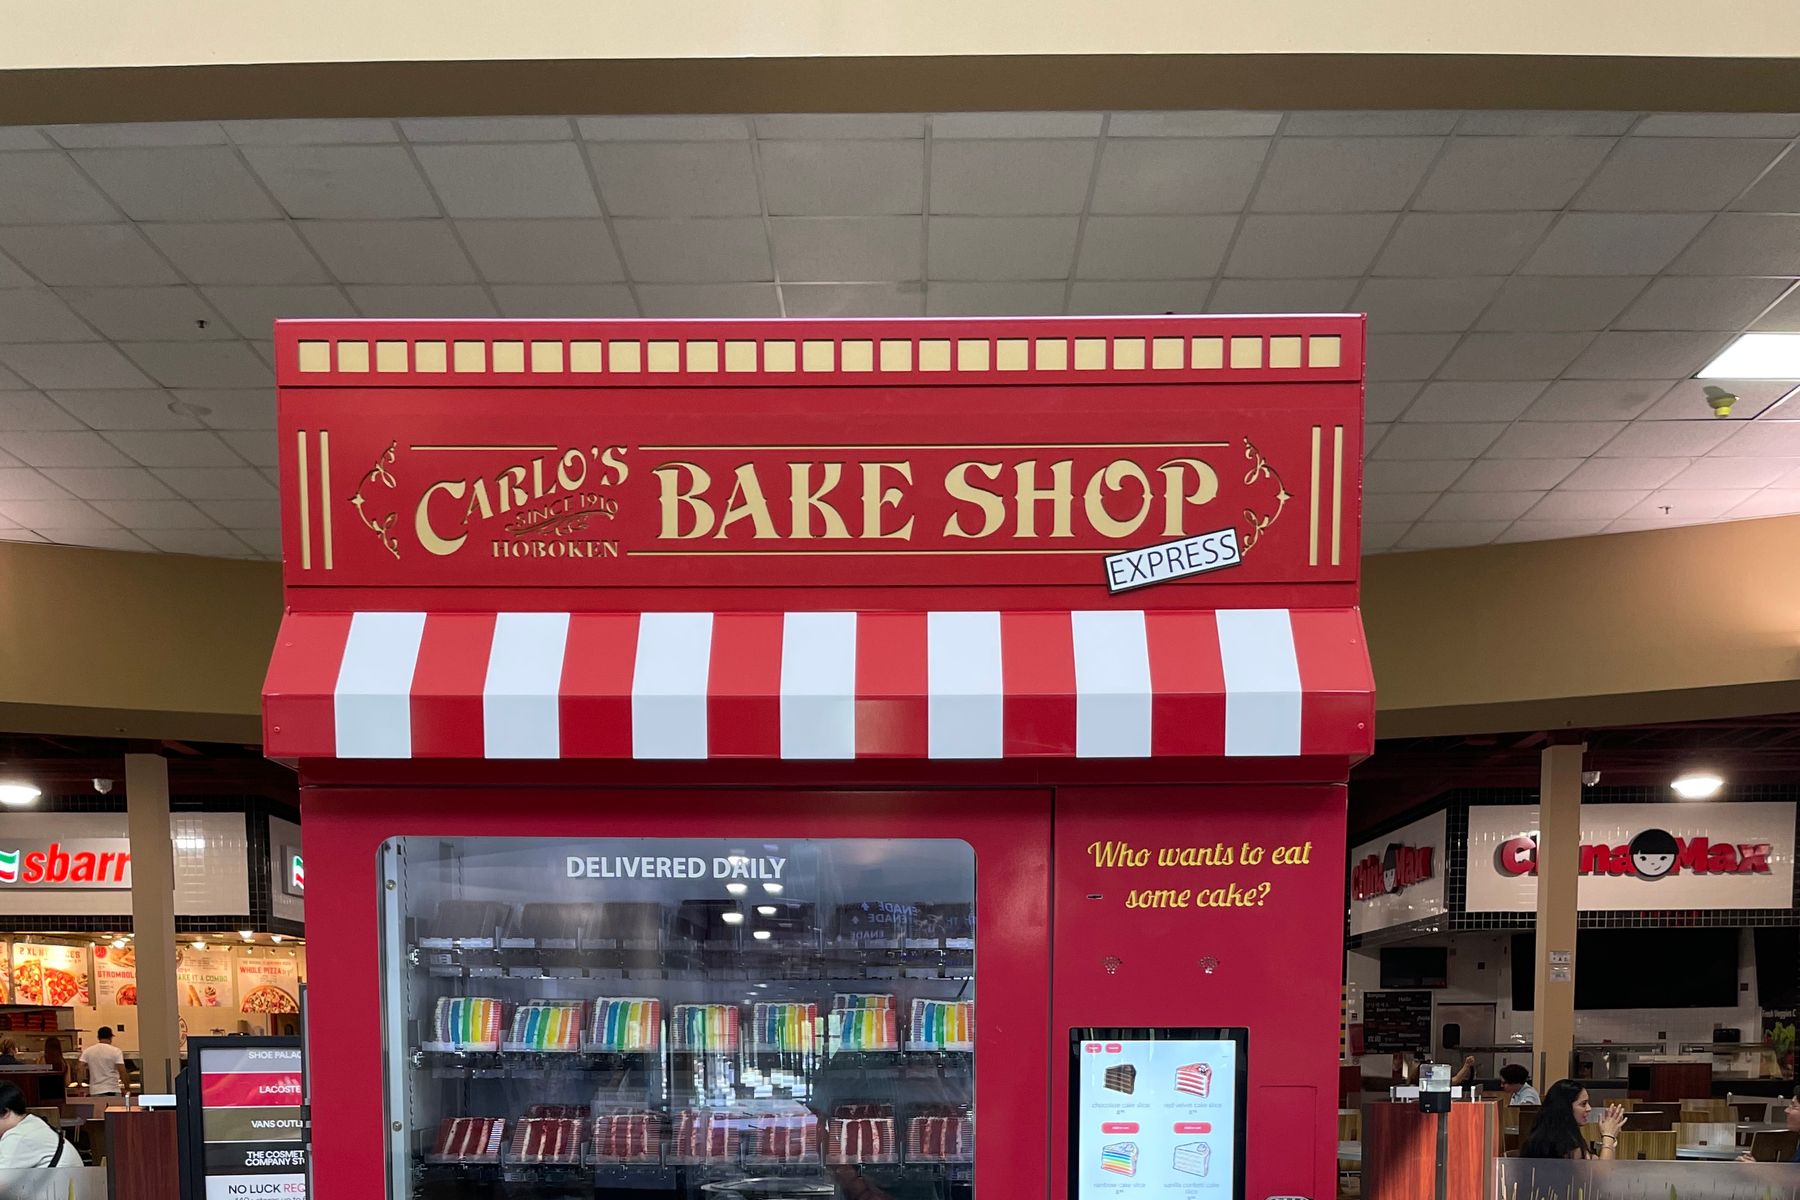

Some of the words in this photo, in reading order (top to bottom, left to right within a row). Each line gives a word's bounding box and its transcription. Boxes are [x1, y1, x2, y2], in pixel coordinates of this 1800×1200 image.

[416, 445, 629, 557] CARLO'S
[651, 460, 915, 542] BAKE
[943, 457, 1220, 540] SHOP
[515, 495, 574, 527] SINCE
[580, 493, 619, 515] 1910
[491, 540, 620, 558] HOBOKEN
[1110, 533, 1238, 586] EXPRESS
[1087, 840, 1152, 868] Who
[1157, 842, 1235, 867] wants
[1239, 842, 1266, 866] to
[1271, 841, 1313, 865] eat
[1501, 836, 1637, 876] Cna
[1676, 836, 1772, 876] Max
[566, 856, 707, 878] DELIVERED
[713, 857, 787, 879] DAILY
[1125, 886, 1191, 909] some
[1196, 881, 1272, 907] cake?
[240, 966, 261, 974] WHOLE
[264, 967, 281, 975] PIZZA
[248, 1051, 273, 1059] SHOE
[259, 1086, 301, 1094] LACOSTE
[251, 1120, 276, 1128] VANS
[277, 1120, 303, 1128] OUTL
[245, 1159, 291, 1167] COMPANY
[246, 1151, 265, 1159] THE
[266, 1150, 305, 1159] COSMET
[228, 1184, 247, 1195] NO
[249, 1184, 281, 1194] LUCK
